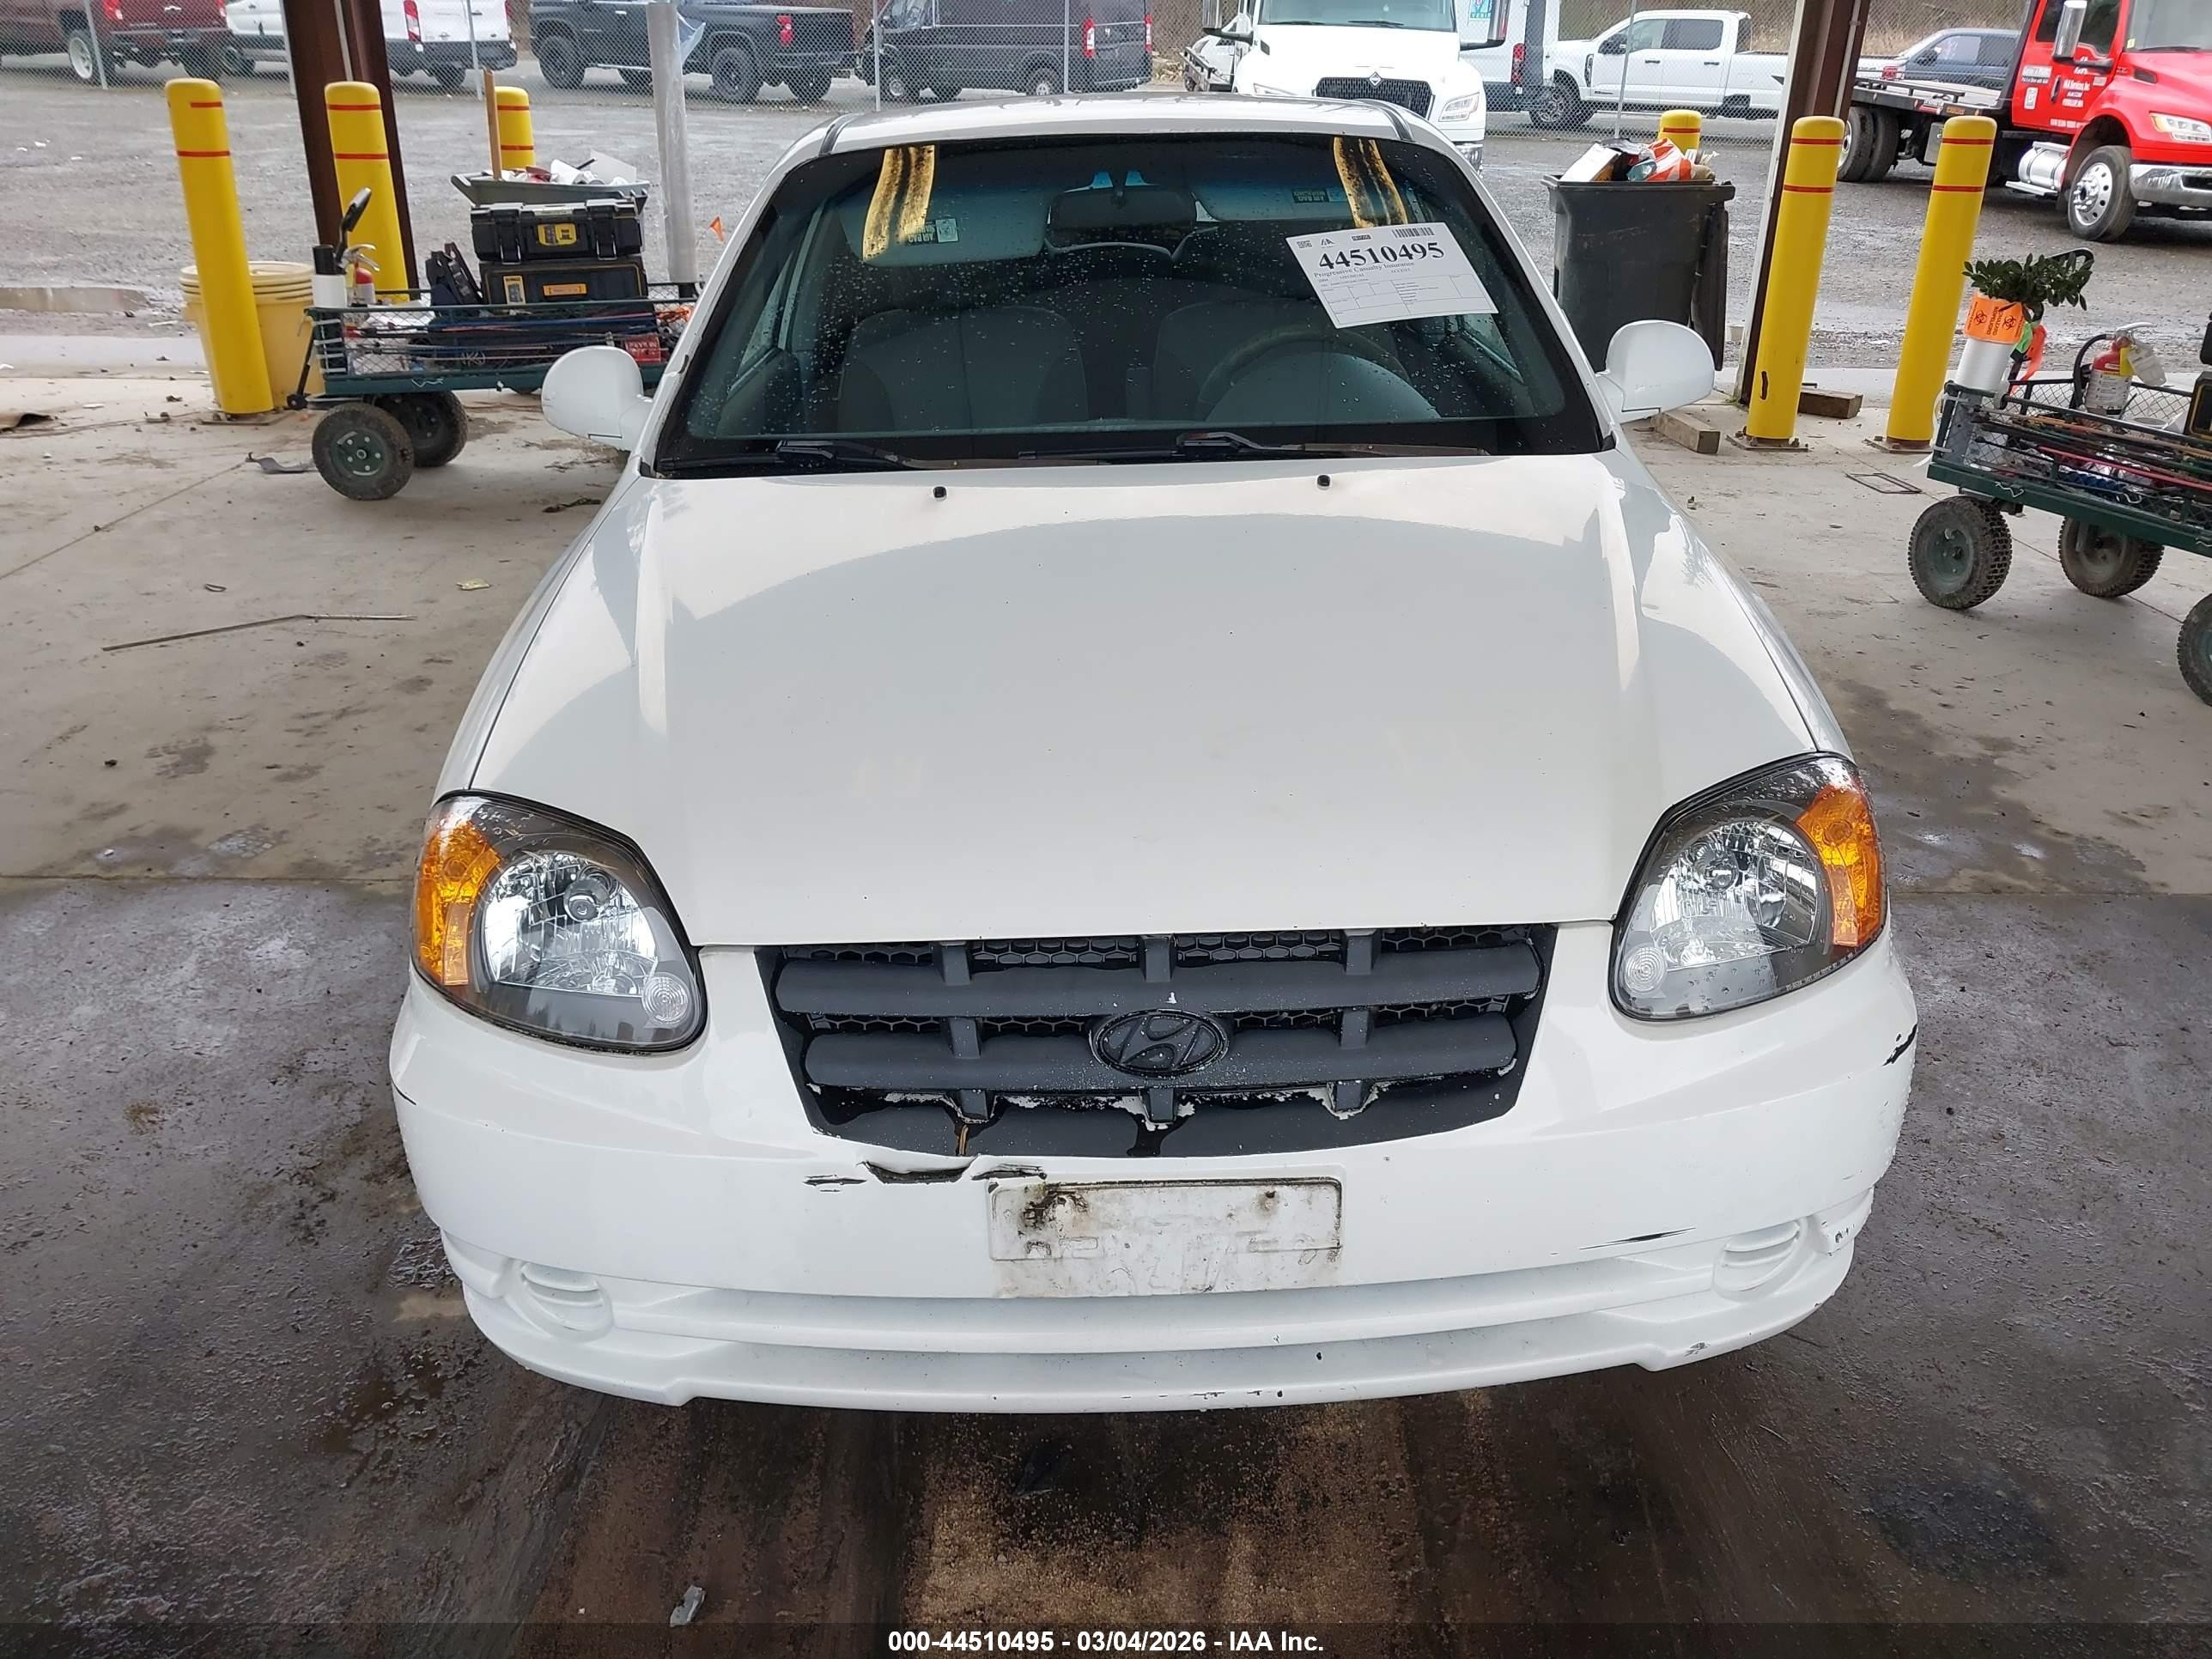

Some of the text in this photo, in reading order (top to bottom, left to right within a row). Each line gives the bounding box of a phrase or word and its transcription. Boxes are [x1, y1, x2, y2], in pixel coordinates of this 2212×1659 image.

[1319, 242, 1444, 269] 44510495
[1314, 261, 1416, 278] Progressive Casualty Insurance
